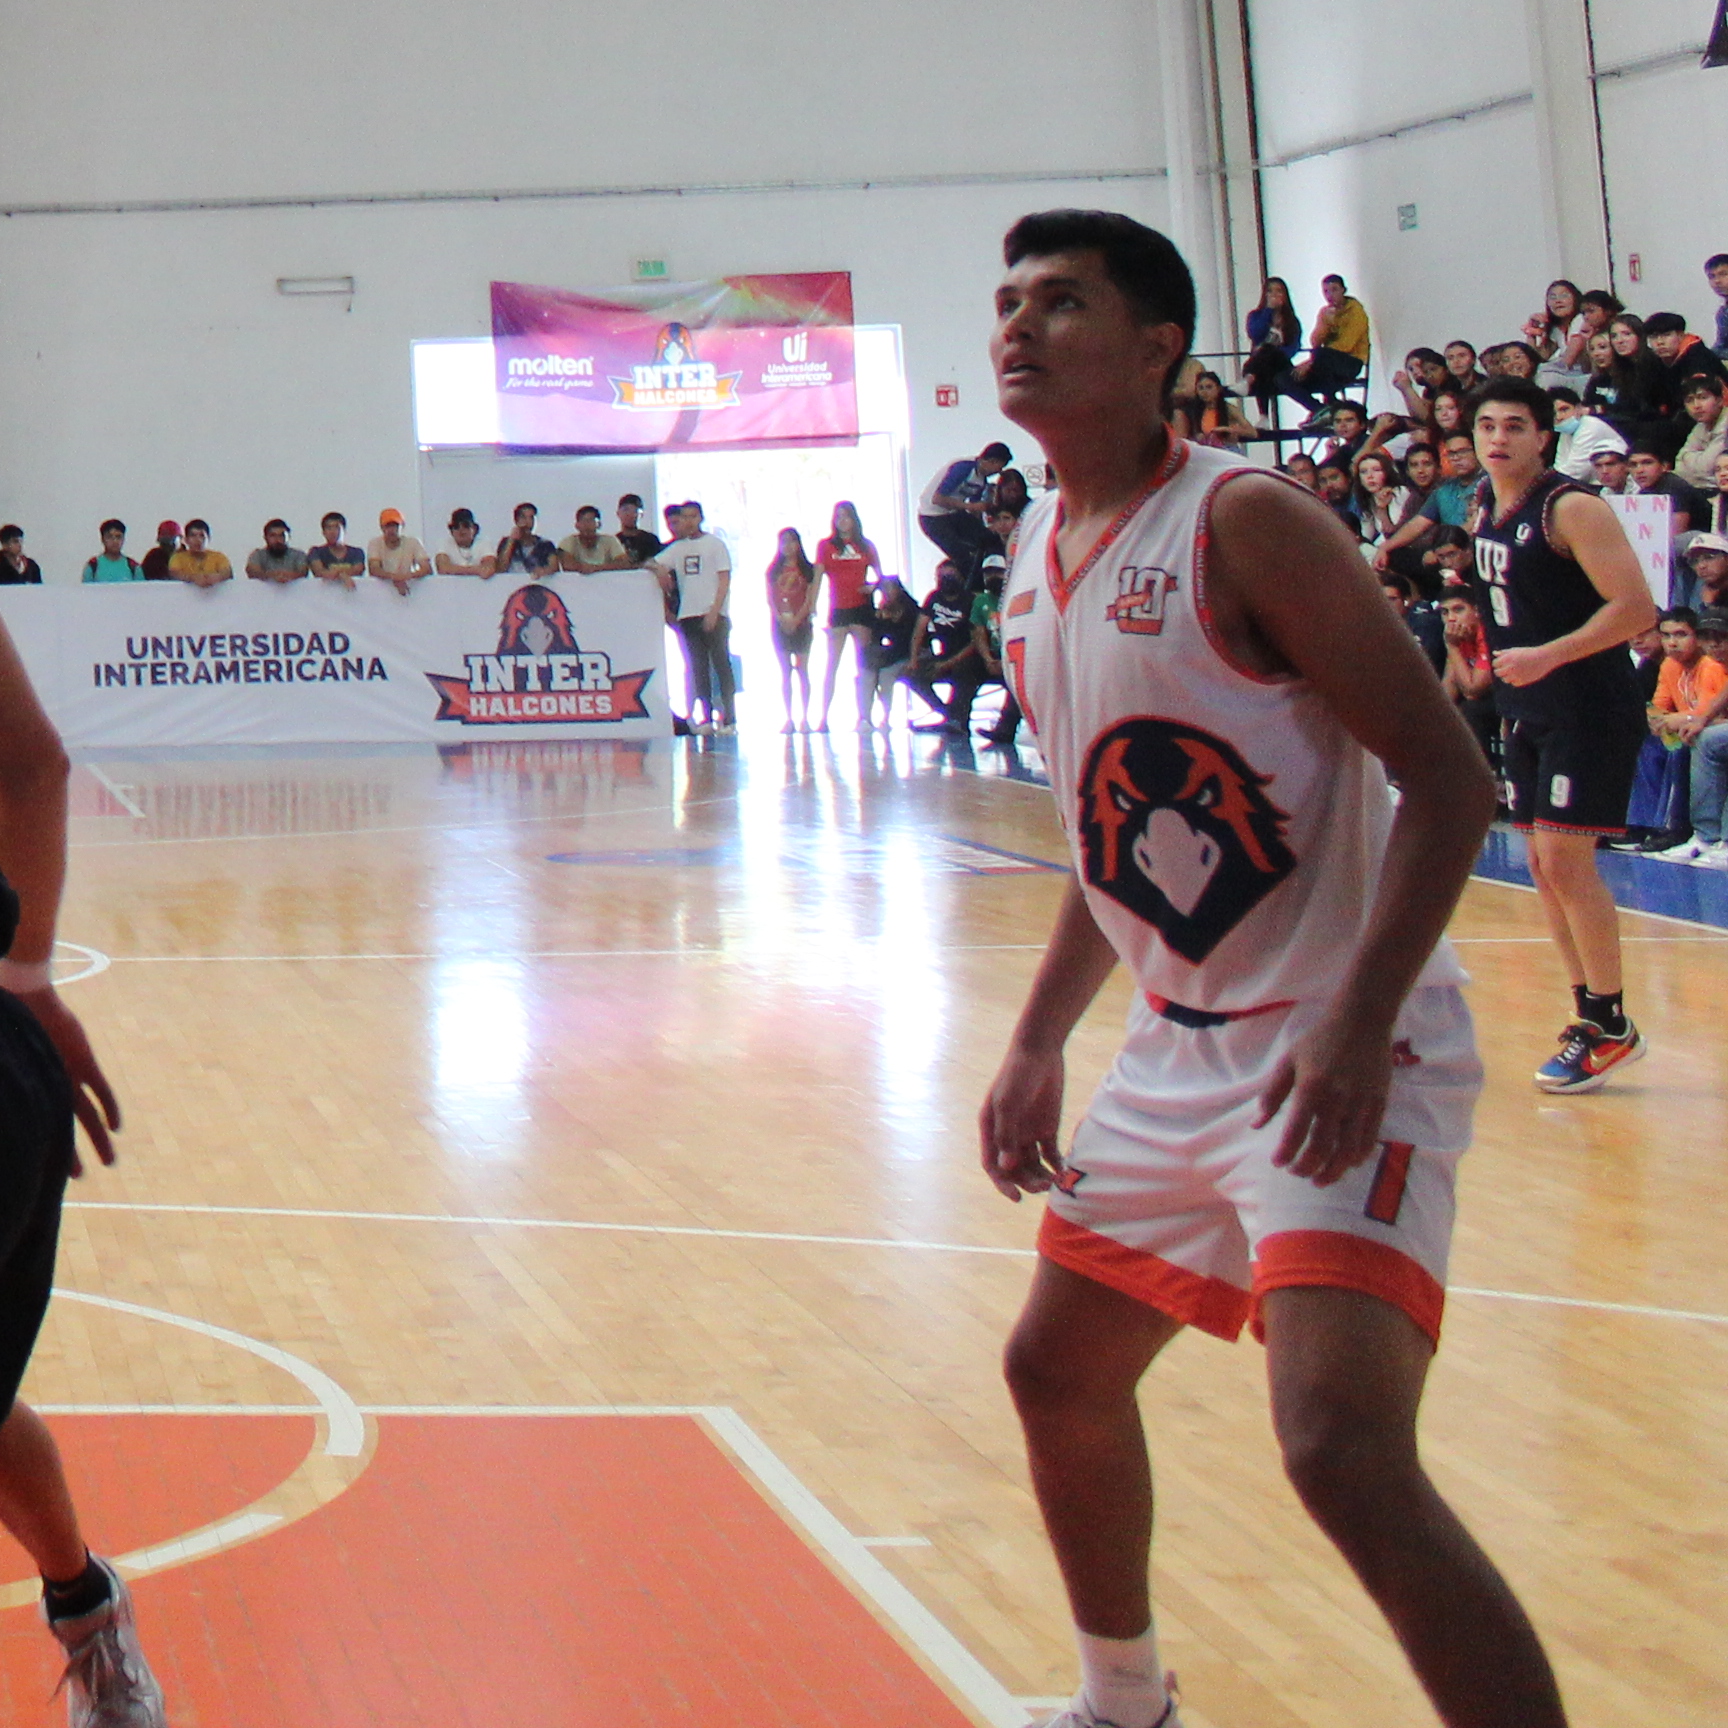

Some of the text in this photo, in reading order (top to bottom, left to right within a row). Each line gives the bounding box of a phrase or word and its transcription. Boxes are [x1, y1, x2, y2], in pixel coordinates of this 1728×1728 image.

[508, 354, 593, 376] molten
[633, 363, 717, 389] INTER
[767, 362, 827, 374] Universidad
[633, 389, 717, 405] HALCONES
[1475, 538, 1511, 585] UP
[1489, 586, 1511, 627] 9
[125, 632, 351, 661] UNIVERSIDAD
[93, 656, 389, 688] INTERAMERICANA
[465, 653, 614, 693] INTER
[469, 694, 614, 718] HALCONES
[1550, 774, 1571, 808] 9
